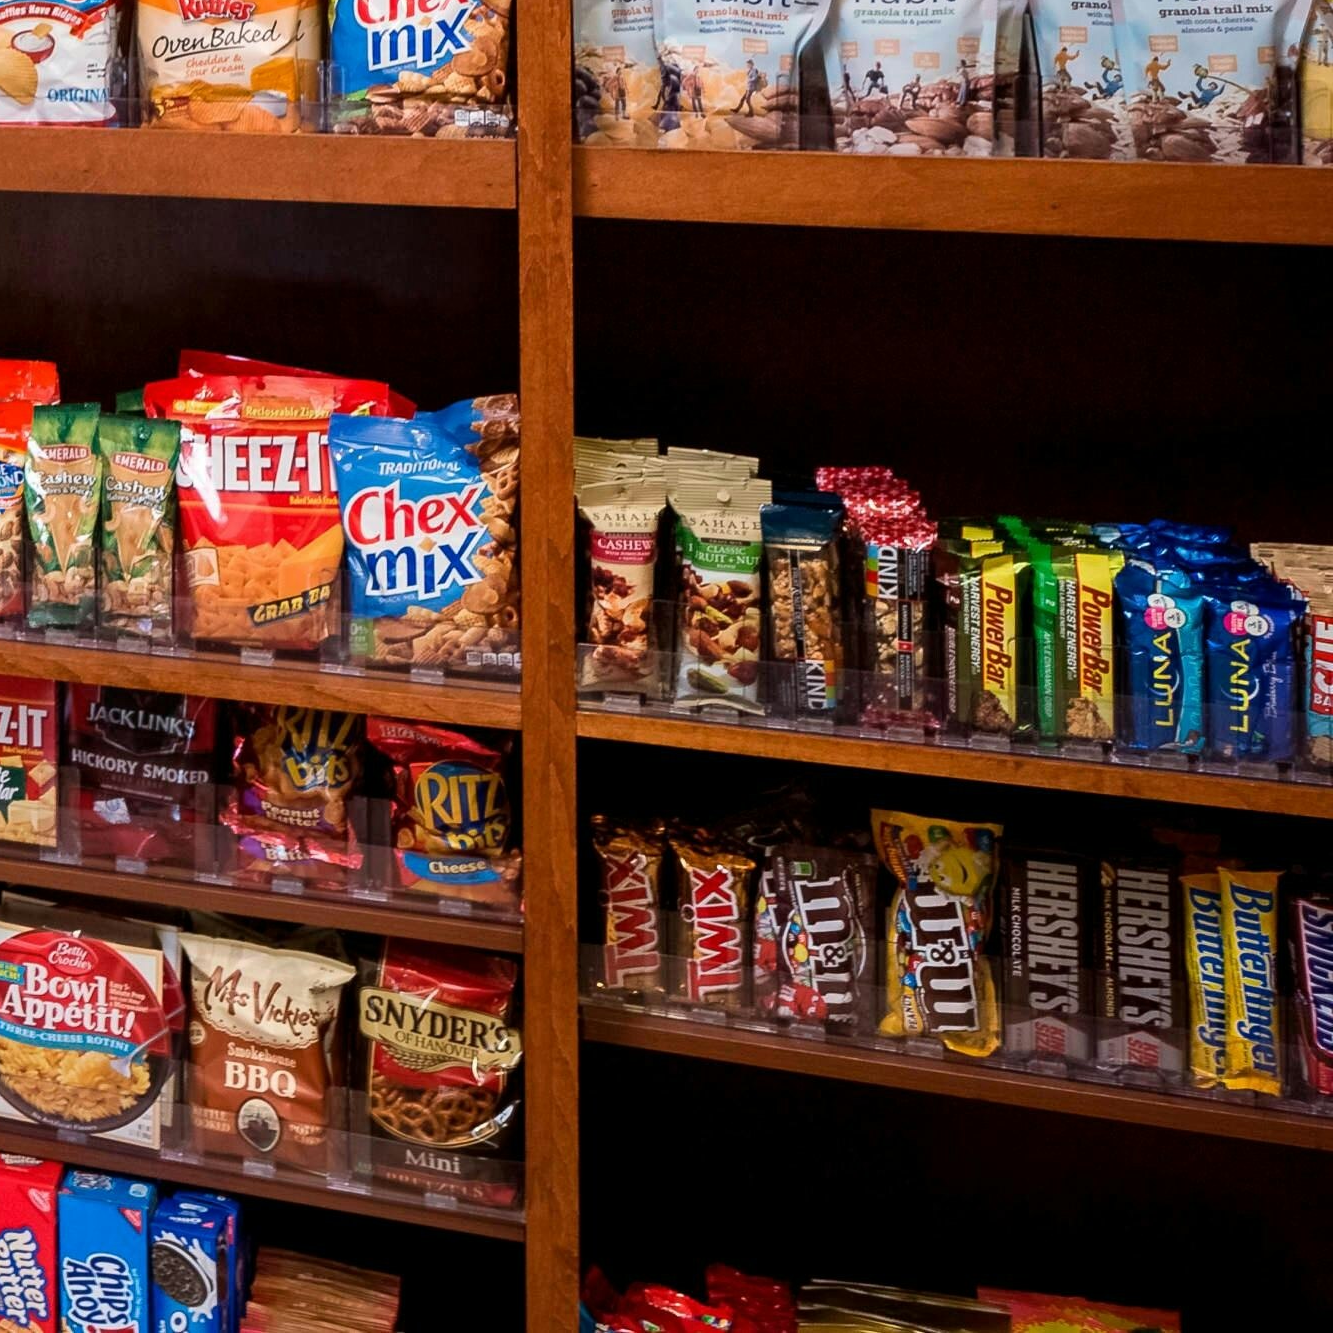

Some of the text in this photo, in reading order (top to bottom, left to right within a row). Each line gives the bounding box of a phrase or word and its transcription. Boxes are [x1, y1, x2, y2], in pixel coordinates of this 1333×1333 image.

[370, 4, 466, 68] mix
[854, 6, 900, 18] granola
[903, 7, 930, 18] trail
[1159, 3, 1273, 18] granola trail mix
[185, 55, 229, 70] Cheddar
[115, 454, 165, 472] EMERALD
[379, 459, 461, 476] TRADITIONAL
[347, 484, 483, 545] Chex
[691, 518, 761, 530] SAHALE
[367, 531, 479, 594] mix
[706, 545, 746, 555] CLASSIC
[878, 546, 898, 600] KIND
[984, 583, 1013, 692] PowerBar
[1082, 586, 1111, 695] PowerBar
[806, 658, 826, 711] KIND
[1154, 631, 1173, 728] LUNA
[1229, 638, 1251, 734] LUNA
[71, 748, 209, 785] HICKORY SMOKED
[418, 772, 501, 826] RITZ
[428, 858, 488, 875] Cheese
[605, 853, 660, 987] TWIX
[688, 867, 742, 1001] TWIX
[1011, 915, 1023, 977] CHOCOLATE
[1026, 860, 1080, 1015] HERSHEY'S
[48, 952, 92, 970] Crocker
[58, 942, 88, 960] Betty
[1117, 868, 1173, 1029] HERSHEY'S
[23, 962, 108, 1006] Bowl
[1230, 880, 1278, 1077] Butterfinger
[0, 1021, 129, 1052] THREE-CHEESE ROTINI
[364, 995, 513, 1053] SNYDER'S
[395, 1030, 480, 1058] OF HANOVER
[224, 1061, 298, 1099] BBQ
[404, 1148, 461, 1174] Mini
[4, 1229, 48, 1318] Nutter
[87, 1253, 130, 1326] Chips
